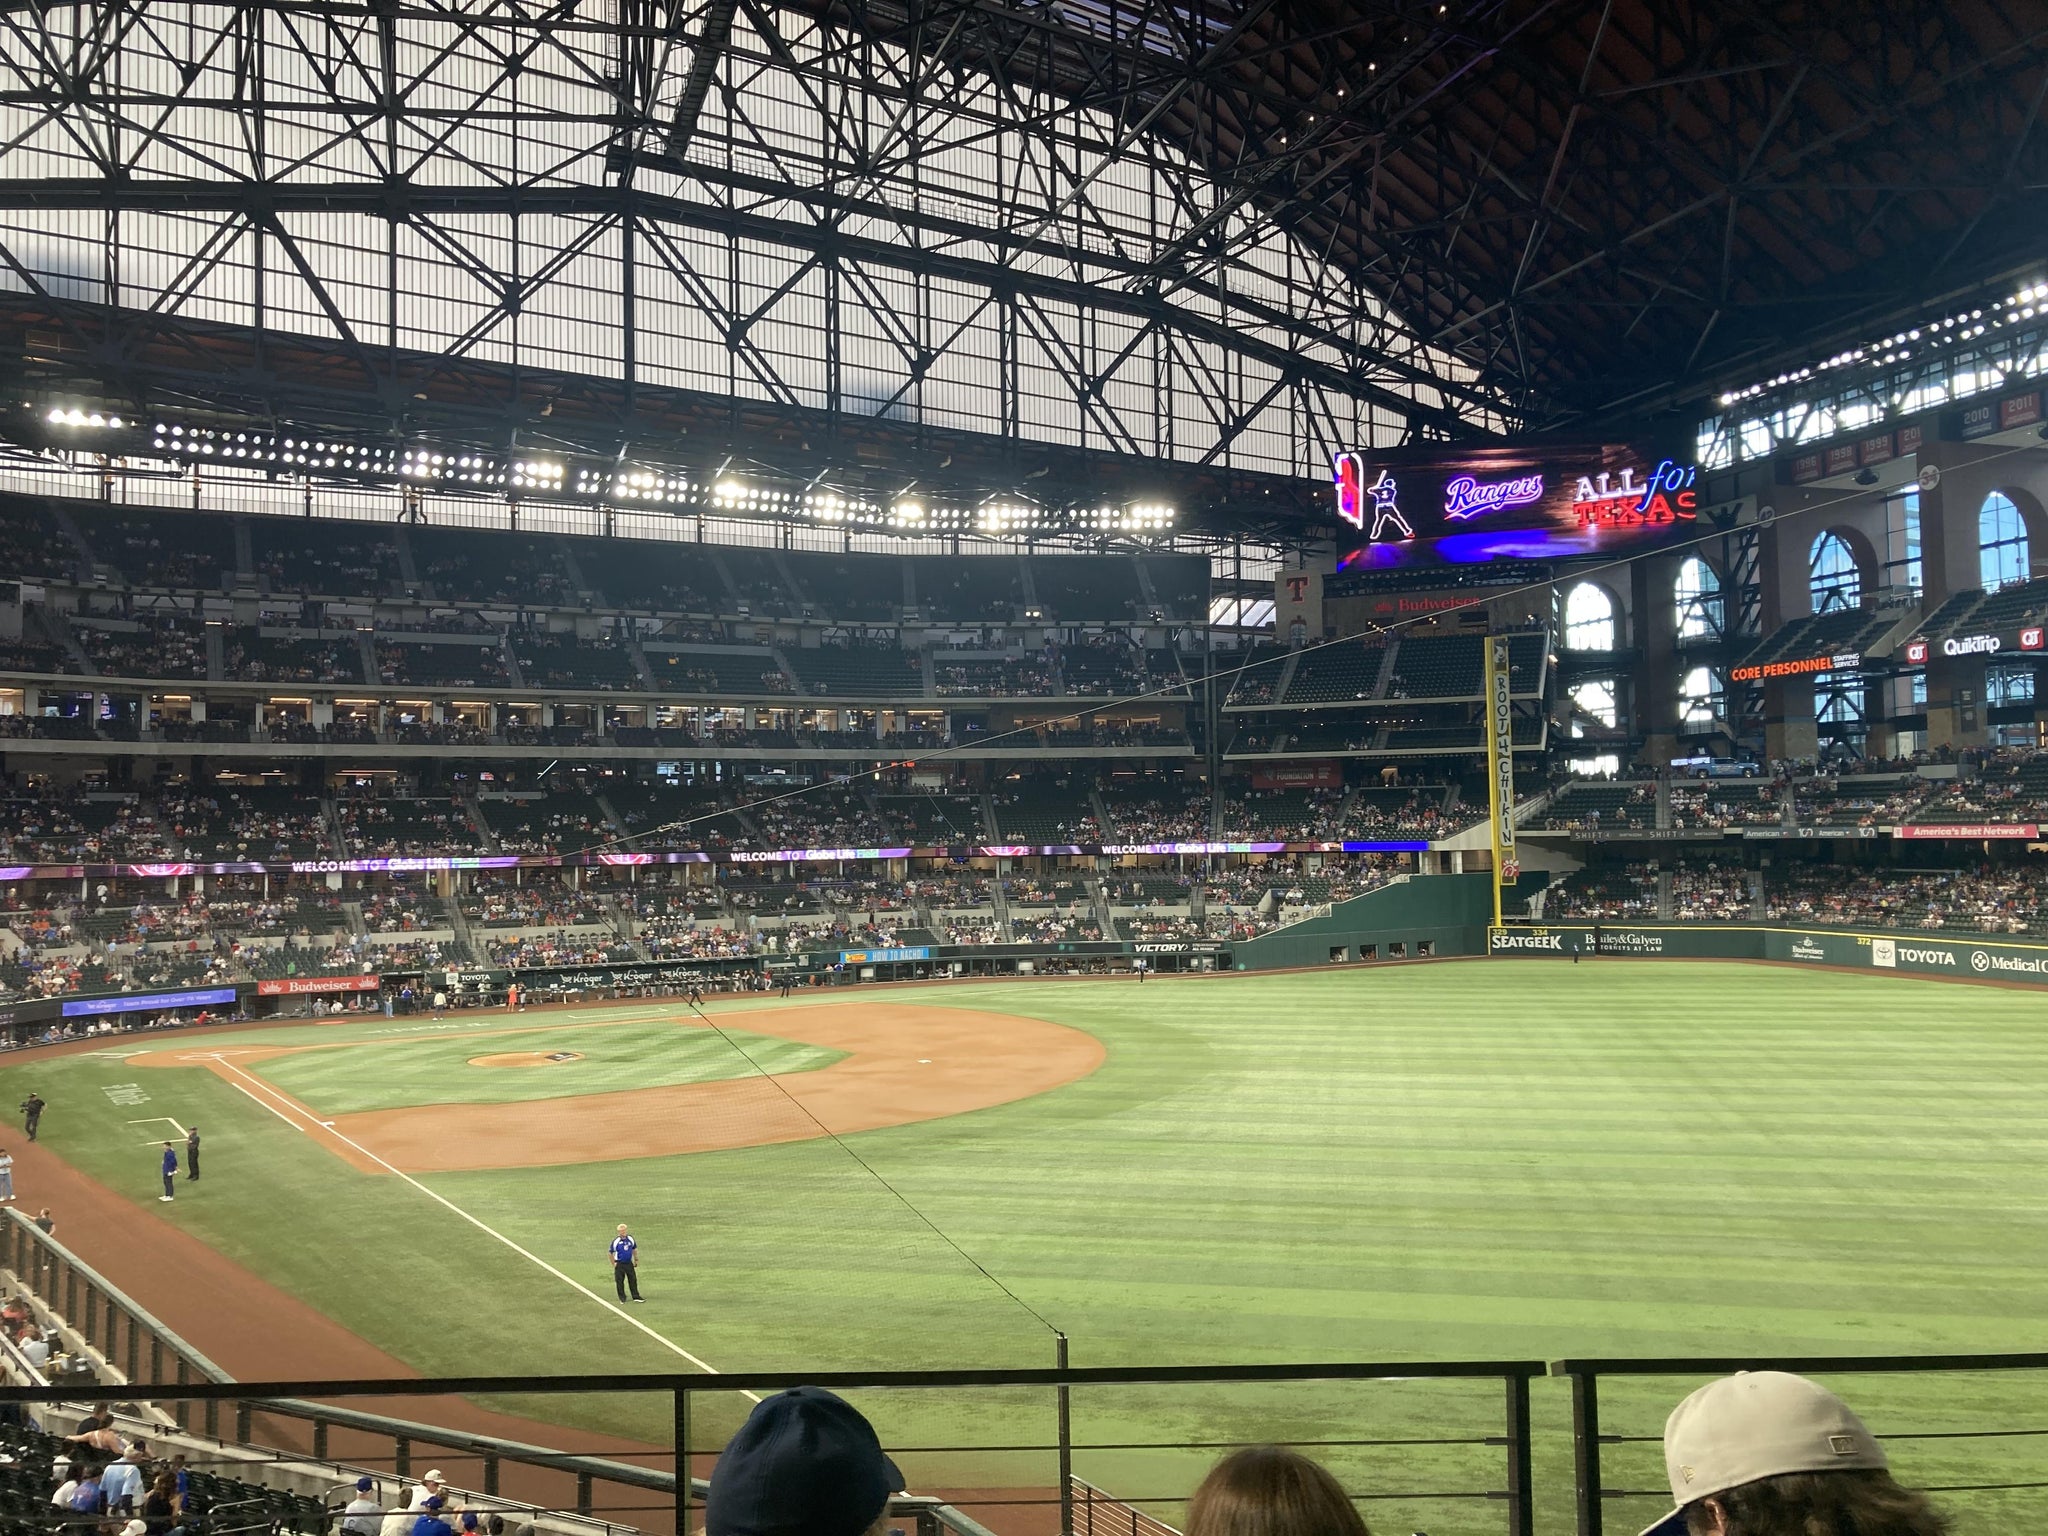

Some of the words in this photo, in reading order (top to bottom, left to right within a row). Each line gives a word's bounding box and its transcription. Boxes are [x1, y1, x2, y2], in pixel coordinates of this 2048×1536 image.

[2009, 395, 2032, 412] 2011
[1963, 407, 1990, 425] 2010
[1866, 436, 1888, 451] 1999
[1831, 446, 1852, 461] 1998
[1796, 456, 1817, 470] 1996
[1574, 467, 1647, 501] ALL
[1920, 470, 1938, 487] 34
[1444, 475, 1543, 520] Rangers
[1573, 492, 1696, 526] TEXAS
[1286, 576, 1309, 603] T
[1400, 596, 1480, 612] Budweiser
[1944, 635, 2000, 656] QuikTrip
[2021, 631, 2040, 645] QT
[1833, 653, 1860, 662] STAFFING
[1909, 646, 1925, 659] QT
[1732, 666, 1761, 681] CORE
[1763, 657, 1833, 677] PERSONNEL
[1834, 660, 1860, 669] SERVICES
[1575, 831, 1602, 840] SHIFT
[1649, 830, 1677, 839] SHIFT
[1914, 827, 1959, 836] America's
[1960, 827, 1982, 836] Best
[1983, 826, 2025, 835] Network
[730, 851, 782, 862] WELCOME
[785, 851, 799, 861] TO
[805, 849, 835, 860] Globe
[836, 848, 855, 860] Life
[1102, 845, 1151, 854] WELCOME
[1154, 844, 1169, 854] TO
[1174, 844, 1205, 853] Globe
[1207, 843, 1227, 853] Life
[292, 860, 357, 872] WELCOME
[363, 859, 380, 871] TO
[387, 858, 424, 870] Globe
[426, 857, 449, 869] Life
[1532, 928, 1548, 937] 334
[1134, 943, 1186, 952] VICTORY
[1492, 935, 1562, 950] SEATGEEK
[1857, 937, 1872, 946] 372
[1898, 948, 1956, 966] TOYOTA
[1991, 956, 2040, 973] Medical
[289, 981, 352, 992] Budweiser
[573, 972, 603, 987] Kroger
